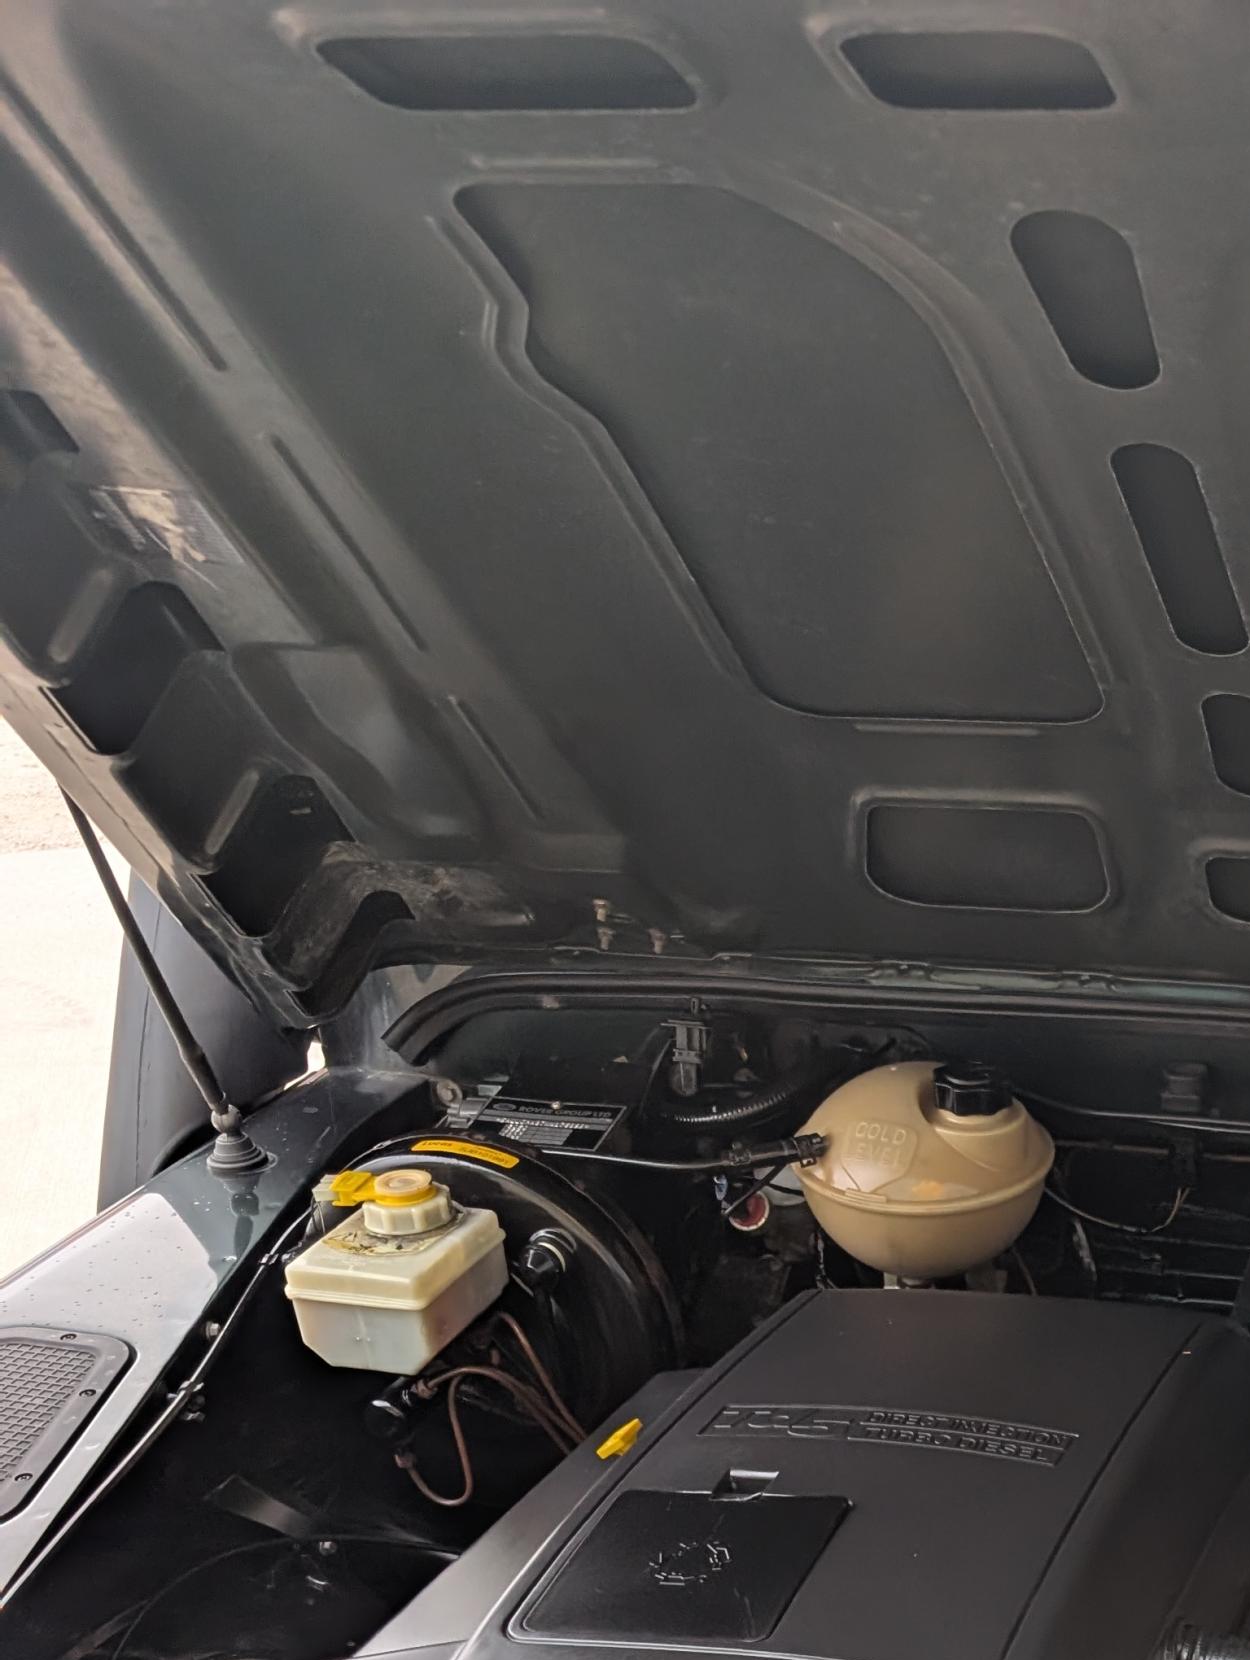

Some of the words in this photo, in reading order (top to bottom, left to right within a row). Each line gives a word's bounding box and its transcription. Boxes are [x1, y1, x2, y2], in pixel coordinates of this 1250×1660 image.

[864, 1426, 952, 1446] TURBO
[959, 1435, 1050, 1462] DIESEL
[869, 1411, 951, 1428] DIRECT
[954, 1417, 1070, 1446] INJECTION
